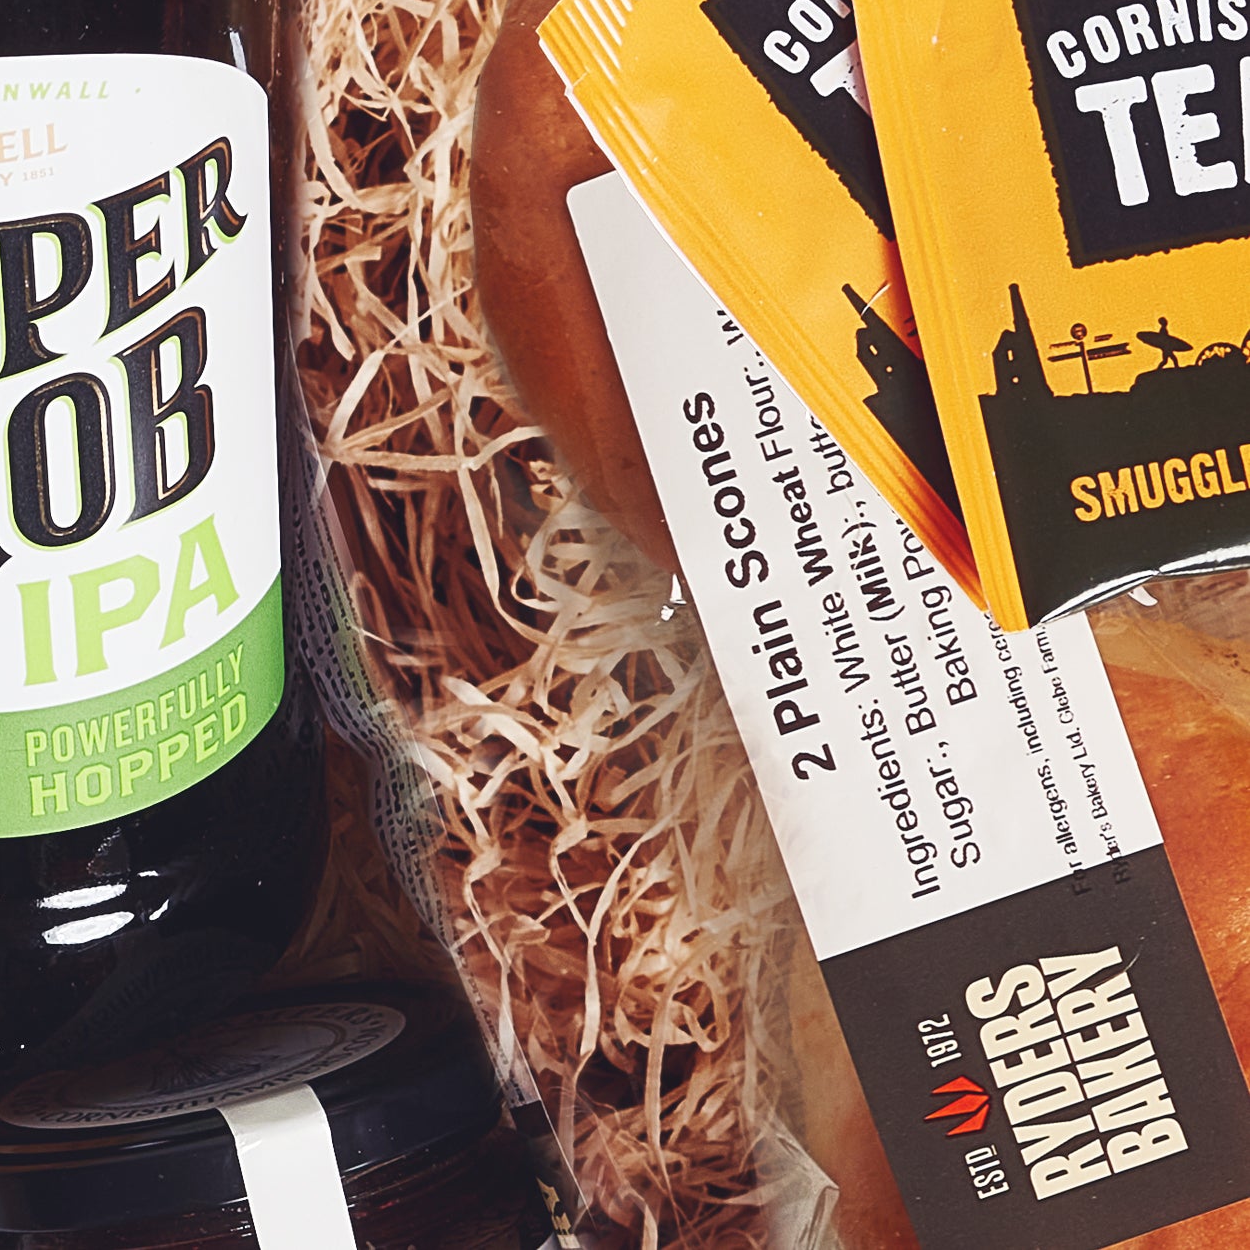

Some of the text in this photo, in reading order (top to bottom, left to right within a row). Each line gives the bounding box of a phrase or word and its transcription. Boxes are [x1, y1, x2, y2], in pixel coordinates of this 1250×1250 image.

[22, 167, 55, 181] 1851
[1073, 55, 1250, 208] TE
[683, 391, 770, 590] Scones
[771, 465, 837, 588] Wheat
[16, 513, 241, 687] IPA
[821, 592, 871, 694] White
[923, 583, 978, 706] Baking
[25, 643, 245, 767] POWERFULLY
[751, 600, 823, 736] Plain
[883, 632, 937, 737] Butter
[1002, 666, 1044, 757] including
[1050, 676, 1075, 725] Glebe
[30, 693, 248, 817] HOPPED
[791, 743, 837, 782] 2
[859, 700, 941, 900] Ingredients:
[1037, 758, 1078, 857] allergens,
[1079, 762, 1109, 820] Bakery
[917, 1012, 1011, 1201] ESTD 1972
[964, 963, 1113, 1201] RYDERS
[1038, 945, 1190, 1174] BAKERY
